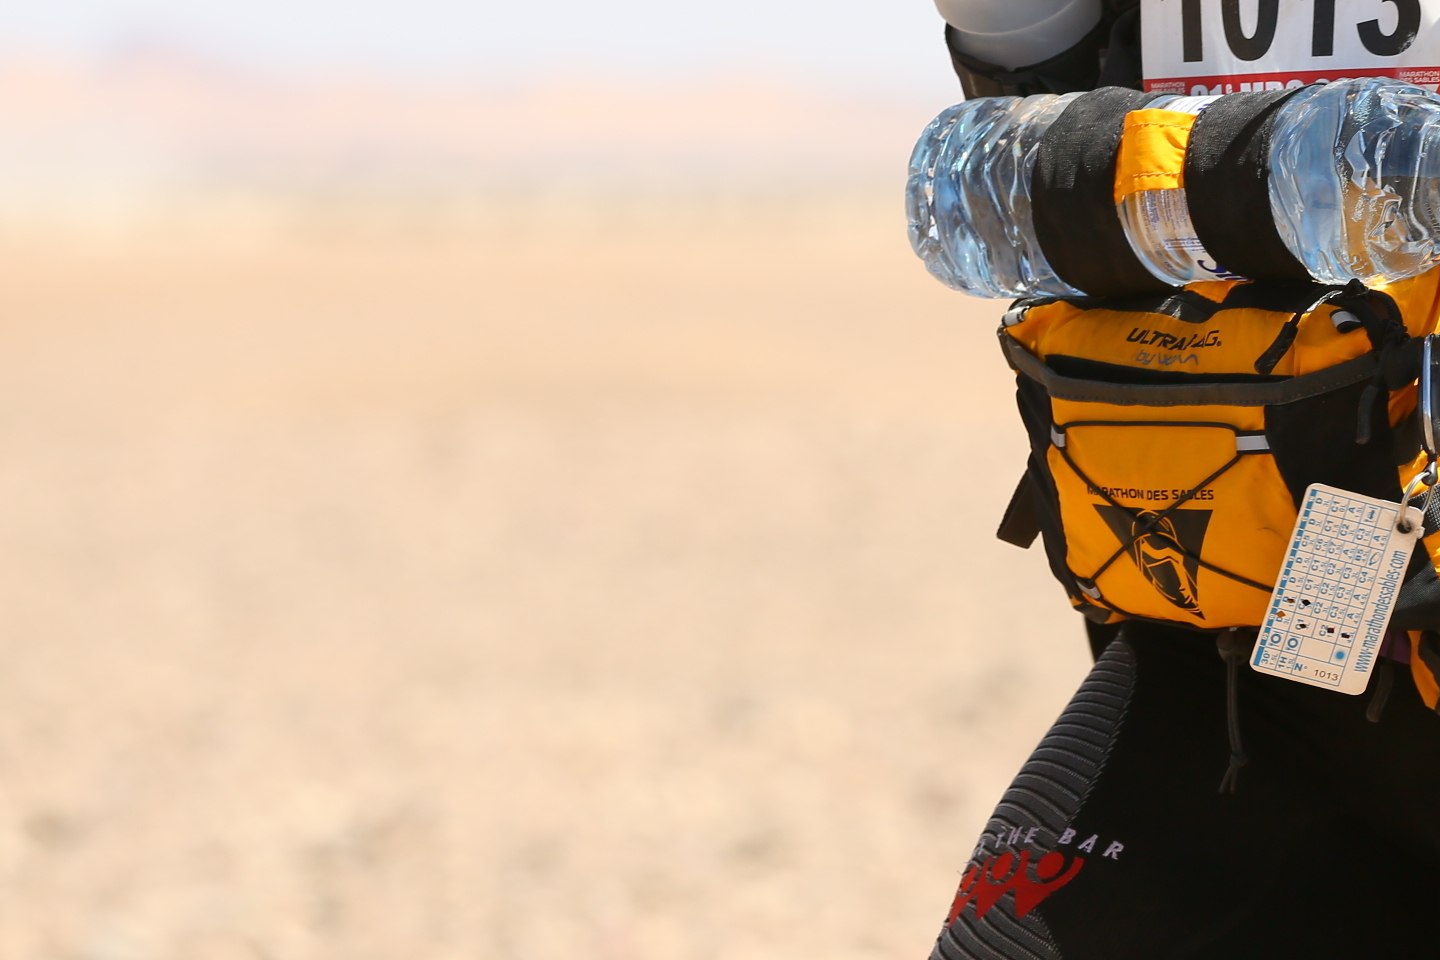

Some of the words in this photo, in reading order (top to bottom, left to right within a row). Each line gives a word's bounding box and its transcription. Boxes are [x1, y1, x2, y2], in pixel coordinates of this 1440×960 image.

[1146, 489, 1169, 501] DES
[1314, 669, 1339, 681] 1013
[994, 826, 1040, 849] THE
[1057, 827, 1125, 861] BAR
